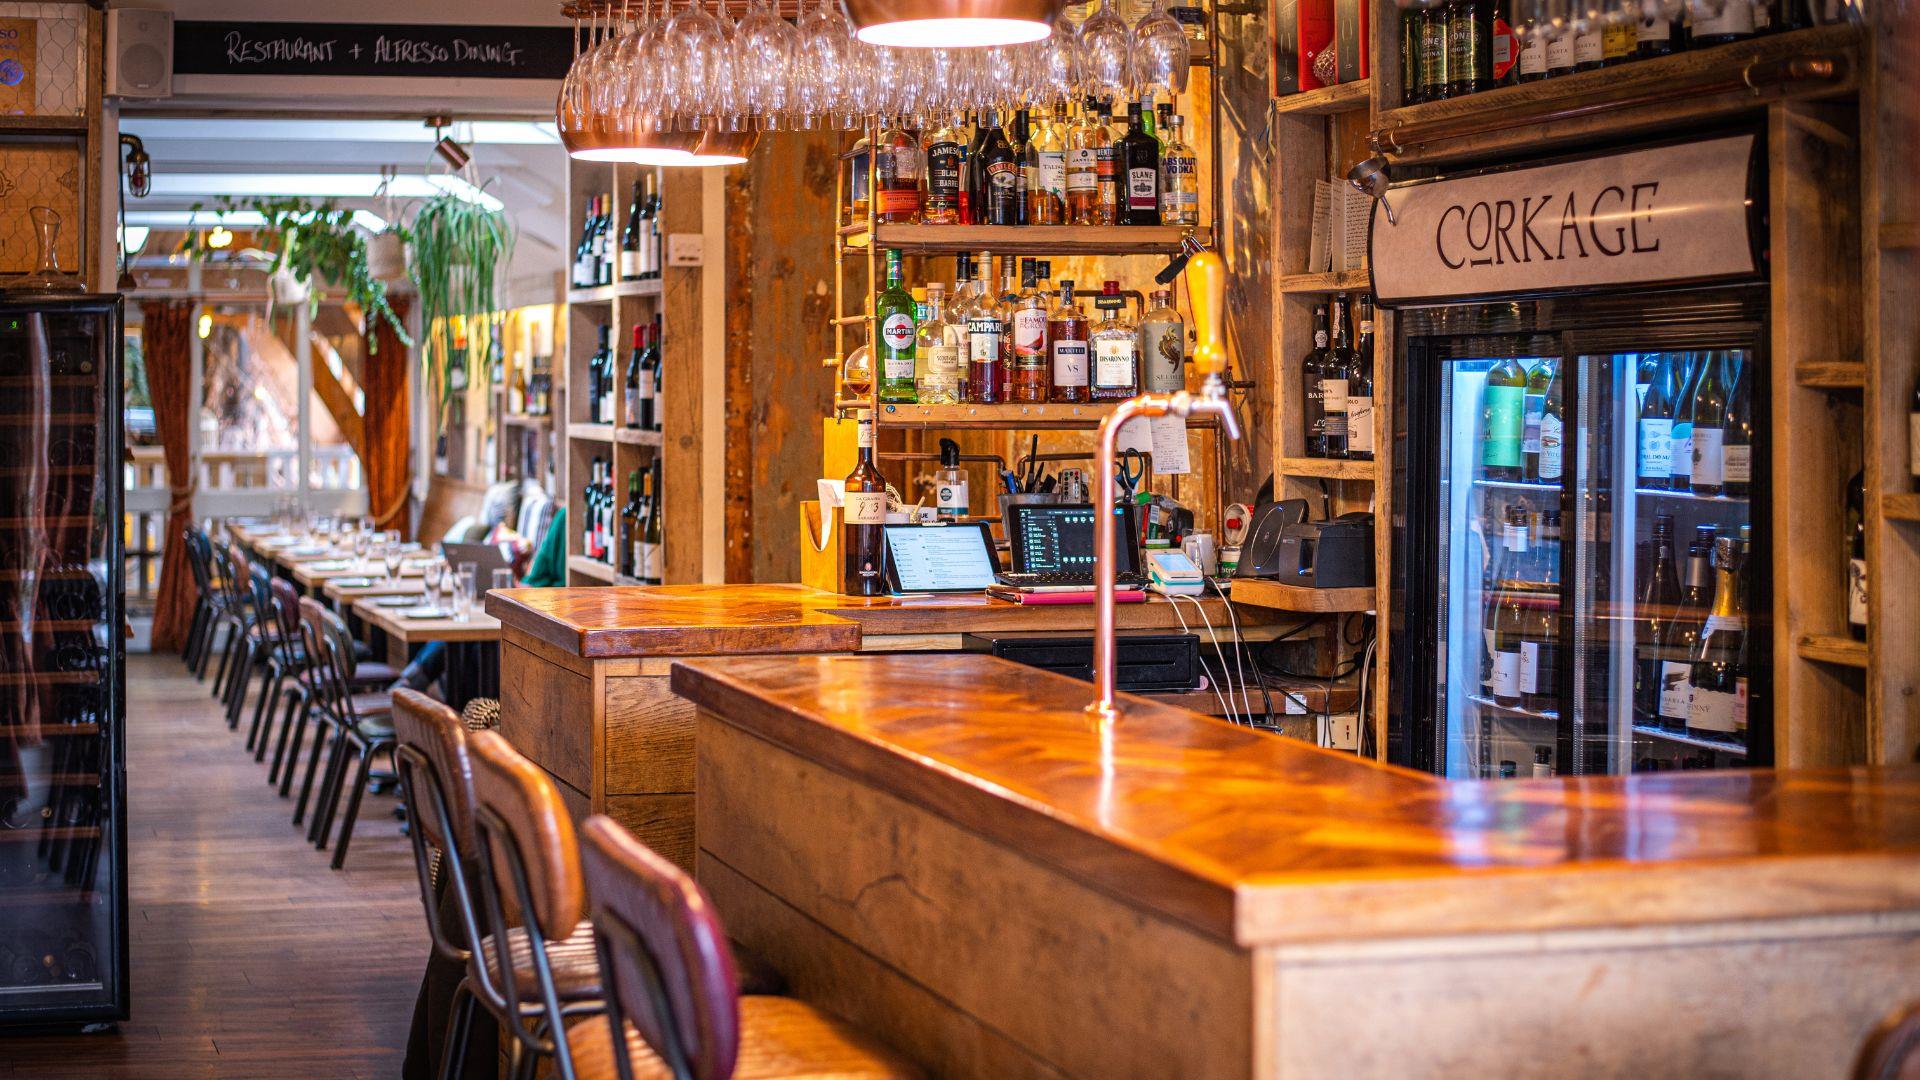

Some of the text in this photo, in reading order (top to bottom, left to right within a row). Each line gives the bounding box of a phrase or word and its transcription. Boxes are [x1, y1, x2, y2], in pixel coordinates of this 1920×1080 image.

[224, 31, 338, 64] RESTAURANT
[348, 44, 364, 60] +
[375, 36, 449, 64] ALFRESCO
[1162, 157, 1197, 166] ABSOLUT
[1166, 165, 1194, 174] VODKA
[1437, 182, 1659, 269] CORKAGE
[968, 323, 1002, 332] CAMPARI
[1099, 355, 1130, 363] DISARONNO
[1067, 364, 1079, 373] VS
